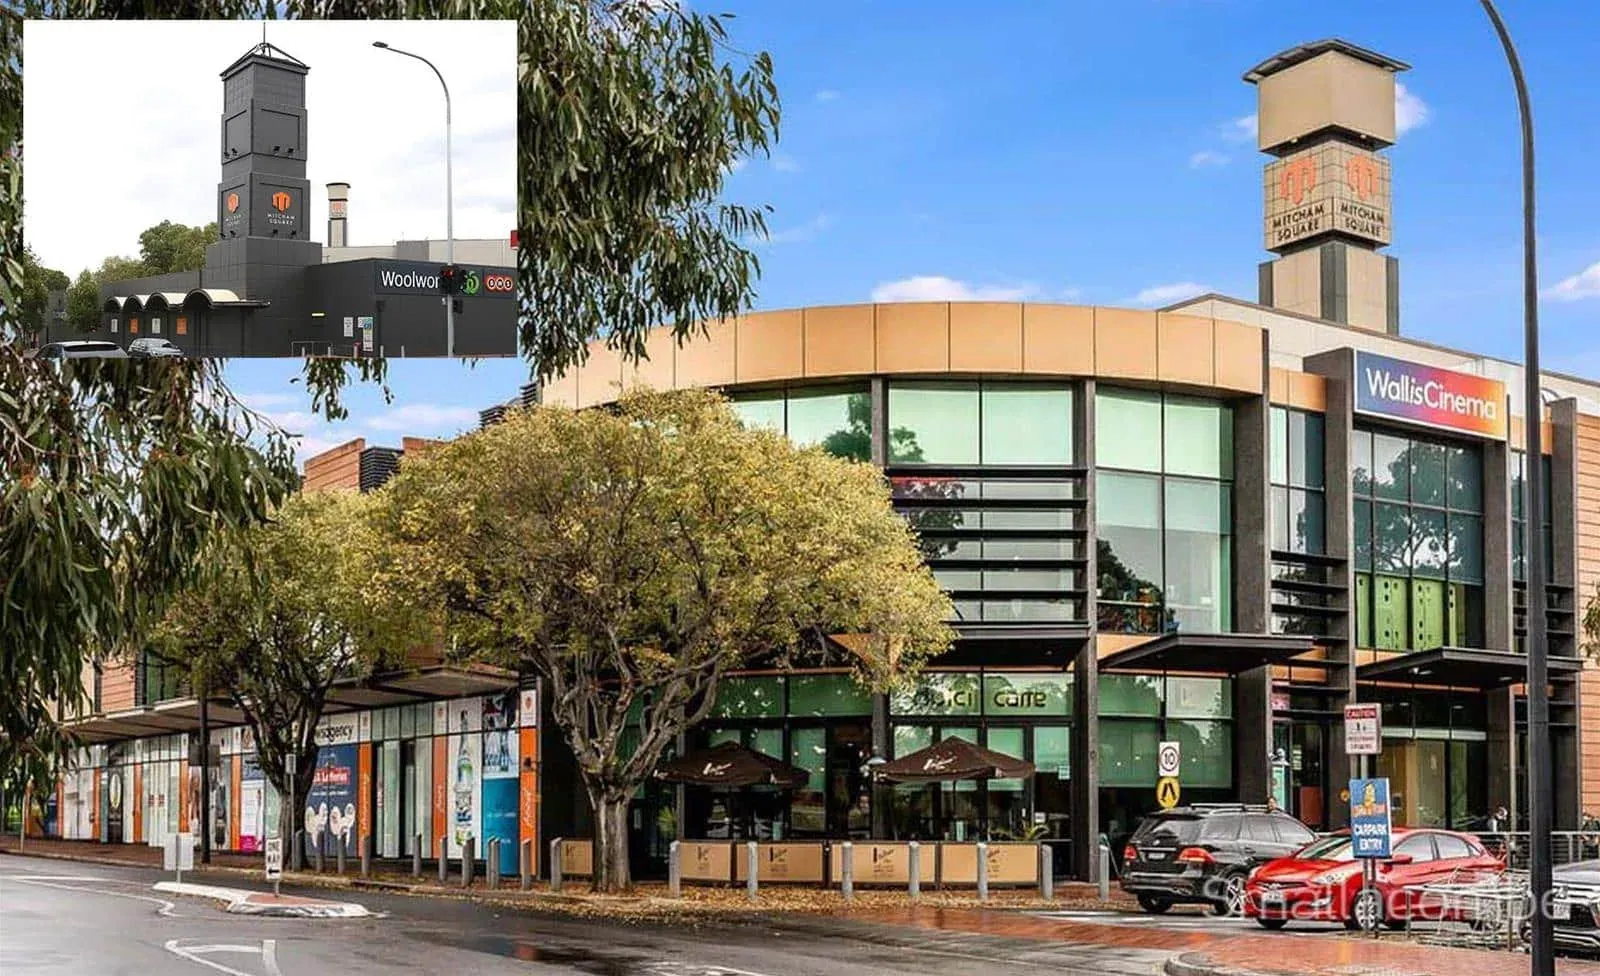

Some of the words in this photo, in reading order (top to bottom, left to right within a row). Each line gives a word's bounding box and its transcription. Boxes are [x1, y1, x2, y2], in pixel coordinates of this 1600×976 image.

[1272, 203, 1325, 229] MITCHAM
[1340, 202, 1385, 224] MITCHAM
[1277, 218, 1320, 241] SQUARE
[1344, 217, 1381, 237] SQUARE
[381, 270, 440, 289] Woolwor
[1366, 367, 1497, 421] WallisCinema
[1164, 752, 1176, 766] 10
